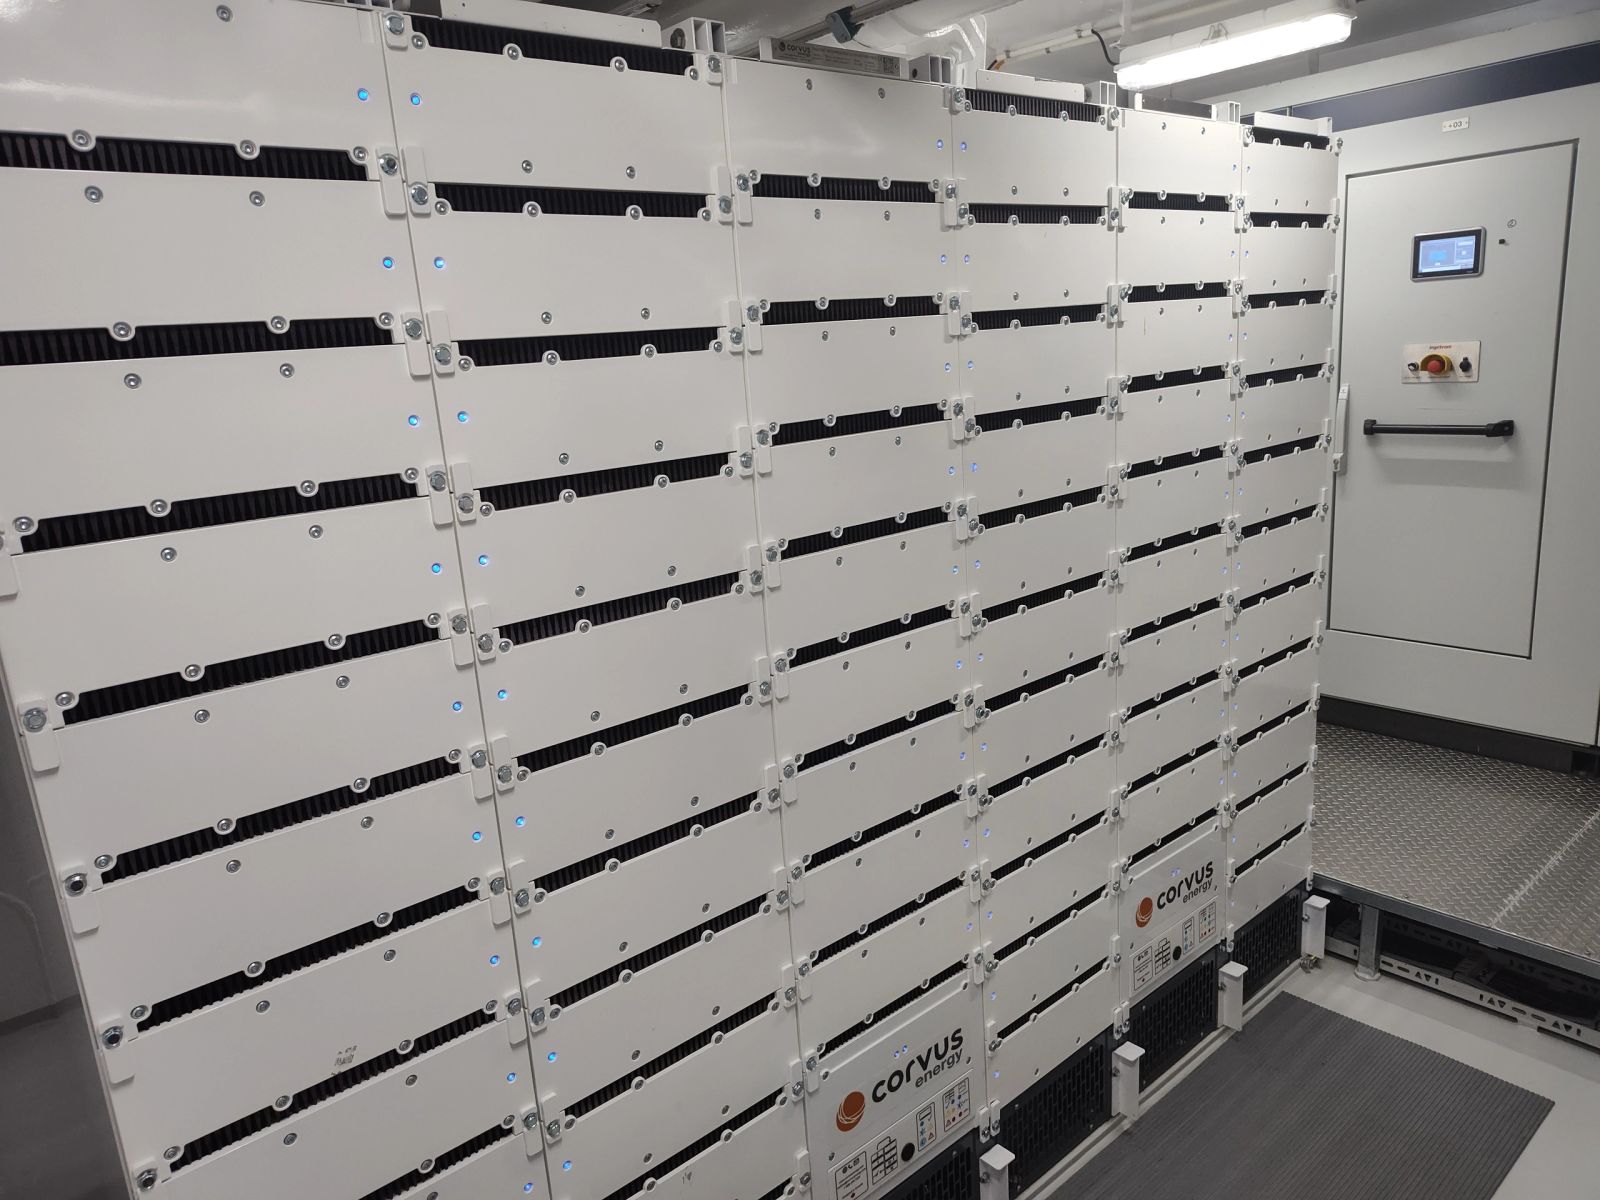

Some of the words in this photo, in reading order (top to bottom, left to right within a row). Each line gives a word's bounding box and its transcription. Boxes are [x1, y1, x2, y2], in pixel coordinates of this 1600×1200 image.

[1156, 861, 1214, 910] corvus
[1182, 878, 1213, 904] energy
[871, 1027, 964, 1103] corvus
[915, 1048, 963, 1088] energy
